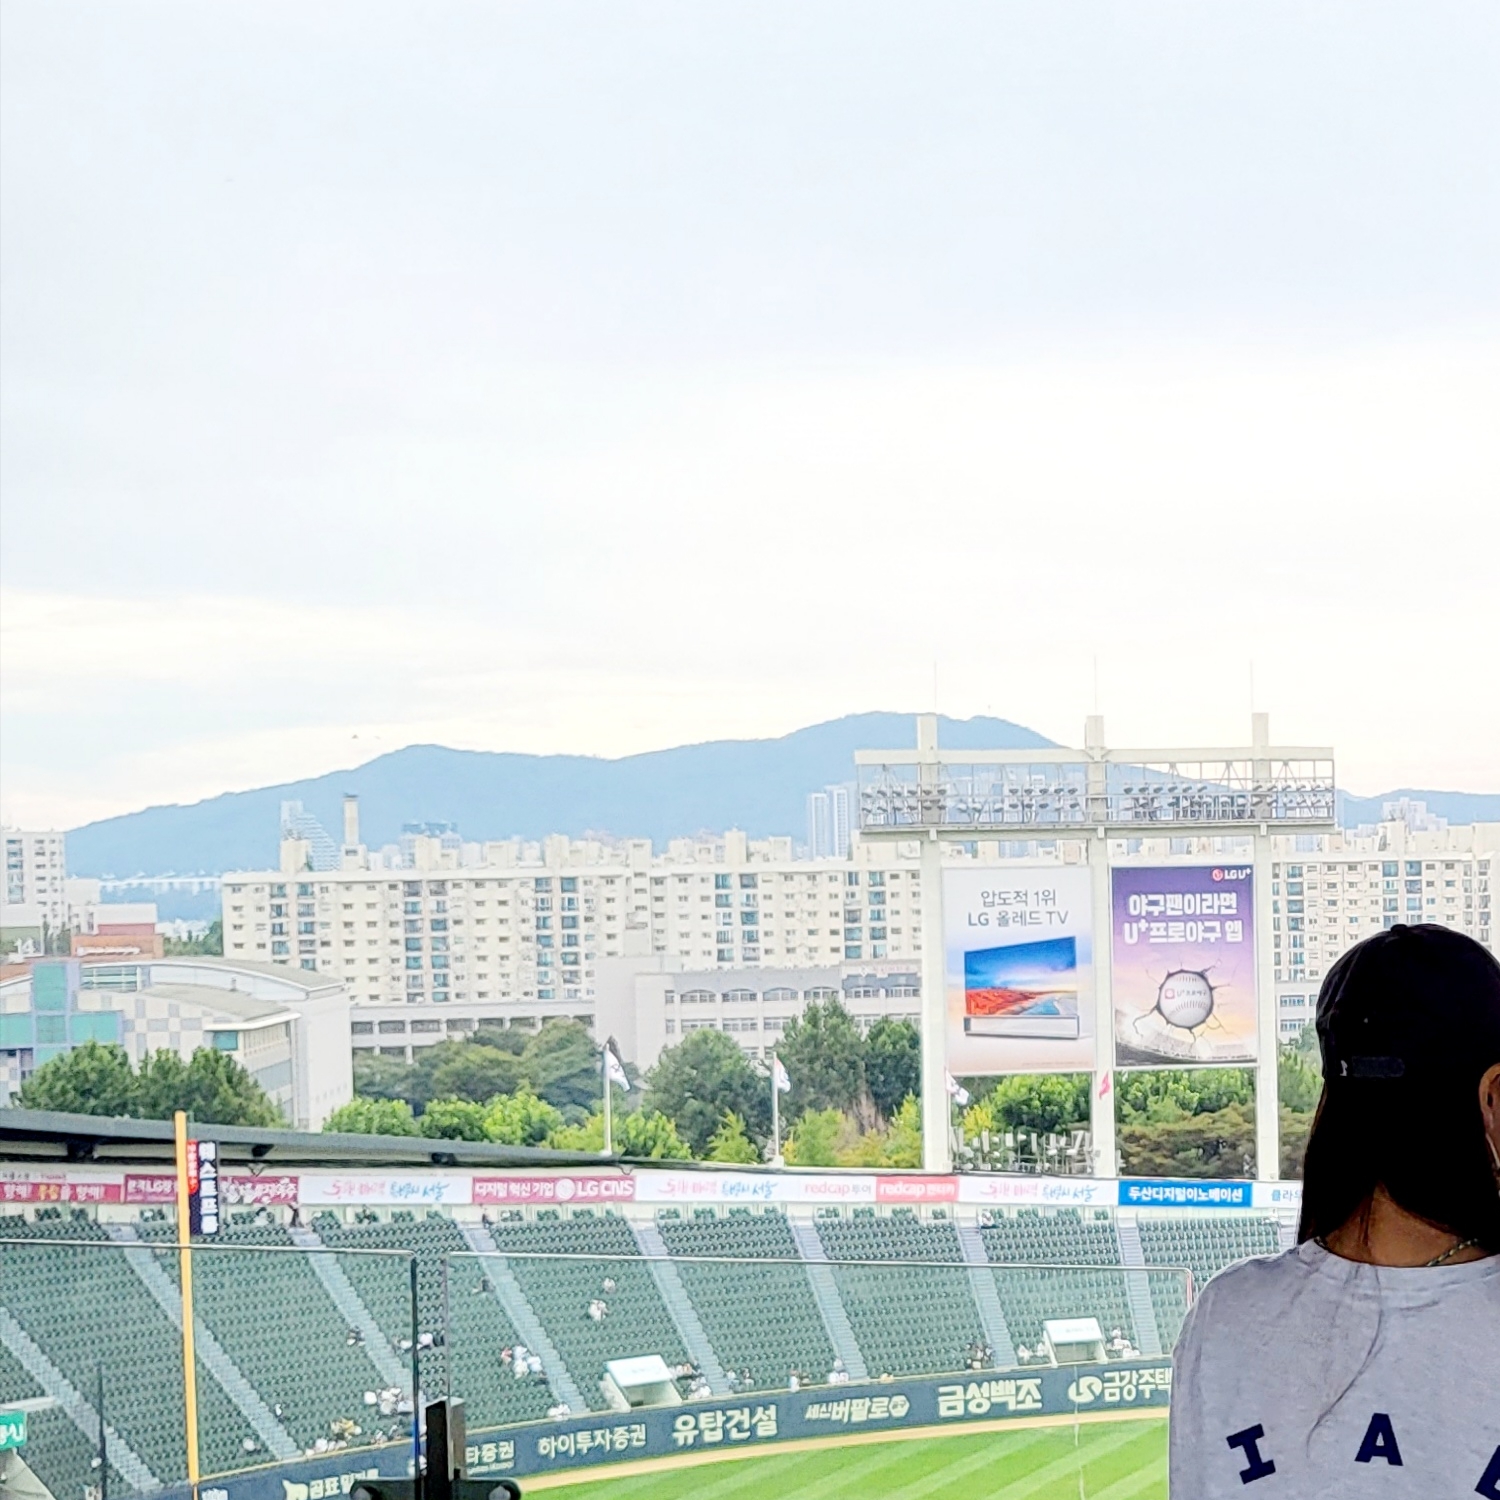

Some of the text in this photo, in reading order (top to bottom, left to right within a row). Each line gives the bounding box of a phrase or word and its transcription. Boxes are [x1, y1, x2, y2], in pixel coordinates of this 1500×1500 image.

[981, 889, 1056, 908] 압도적 1위
[1129, 892, 1237, 917] 야구팬이라면
[967, 910, 1069, 927] LG 올레드 TV
[1225, 919, 1243, 943] 앱
[577, 1181, 599, 1197] LG
[600, 1180, 634, 1197] CNS
[805, 1182, 850, 1196] redcap
[880, 1181, 925, 1198] redcap
[1128, 1186, 1244, 1203] 두산디지털이노베이션
[938, 1377, 1043, 1418] 금성백조
[672, 1403, 778, 1447] 유탑건설
[537, 1423, 647, 1459] 하이투자증권
[465, 1439, 515, 1466] 타증권
